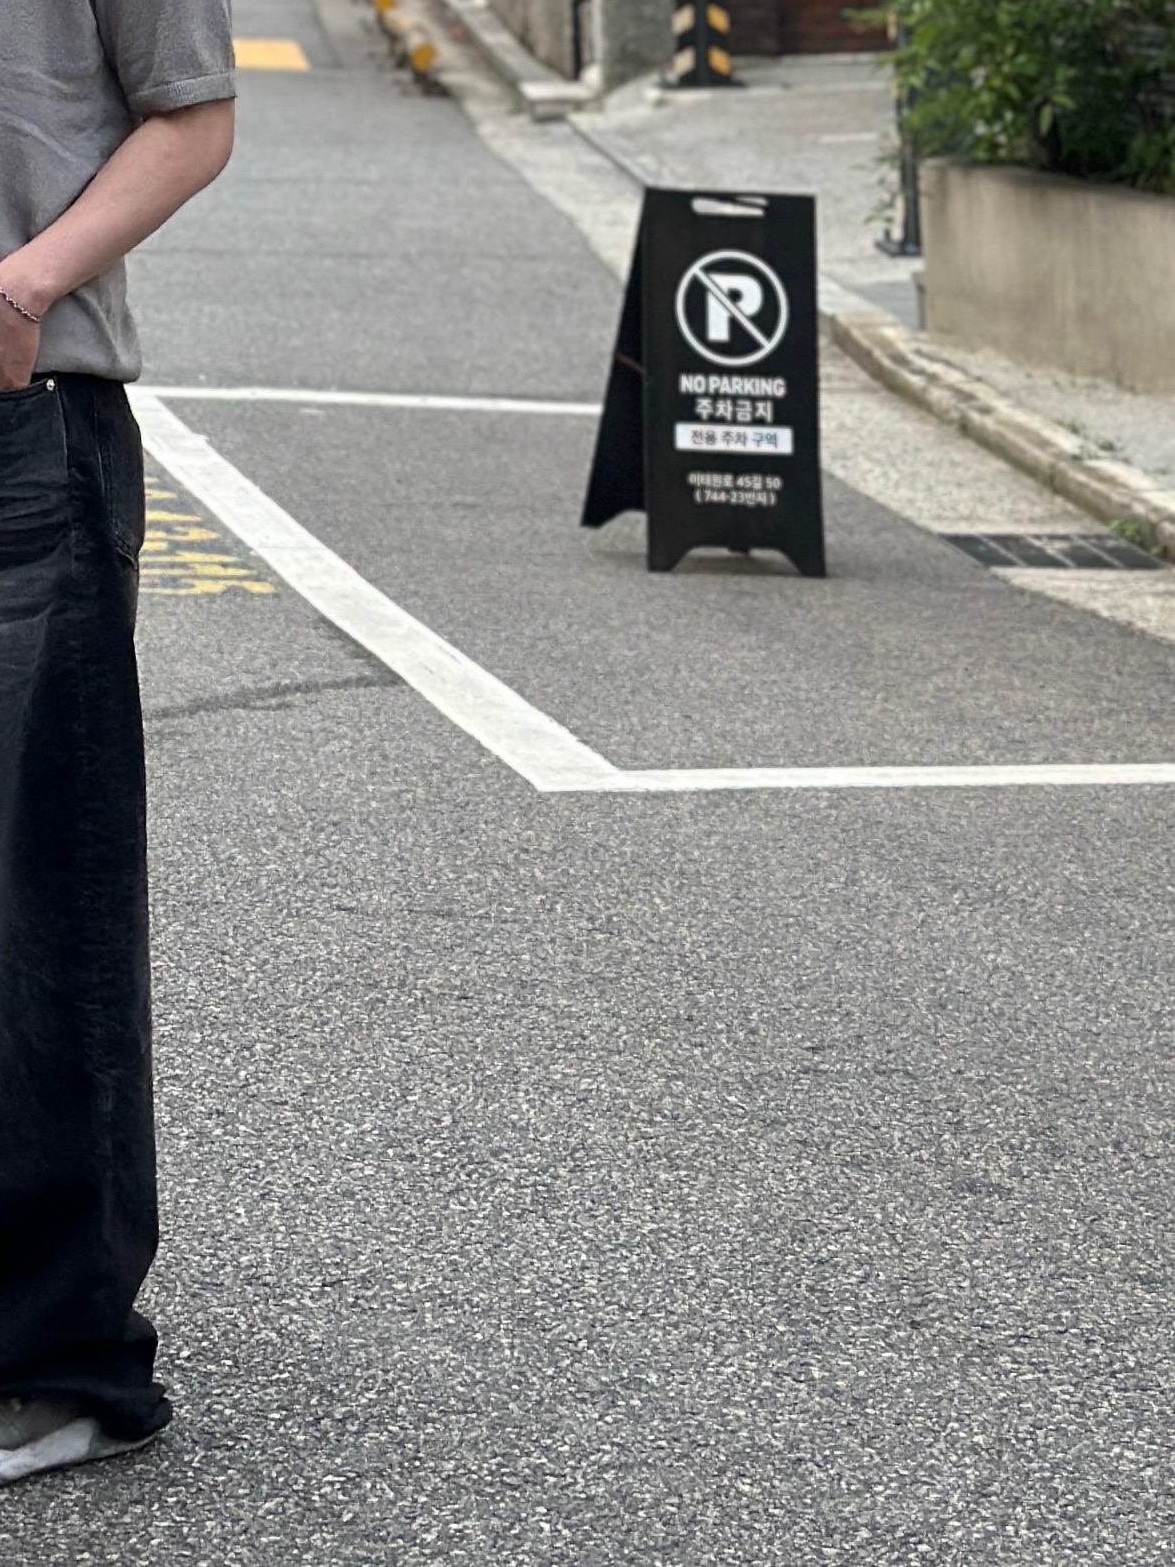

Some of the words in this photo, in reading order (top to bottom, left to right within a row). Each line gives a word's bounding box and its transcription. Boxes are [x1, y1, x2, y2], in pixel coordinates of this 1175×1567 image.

[680, 374, 706, 394] NO
[708, 375, 786, 397] PARKING
[695, 397, 774, 424] 주차금지
[690, 429, 717, 446] 전용
[721, 430, 748, 447] 주차
[752, 432, 778, 449] 구역
[688, 472, 734, 488] 이태원로
[736, 475, 763, 490] 45길
[765, 476, 781, 489] 50
